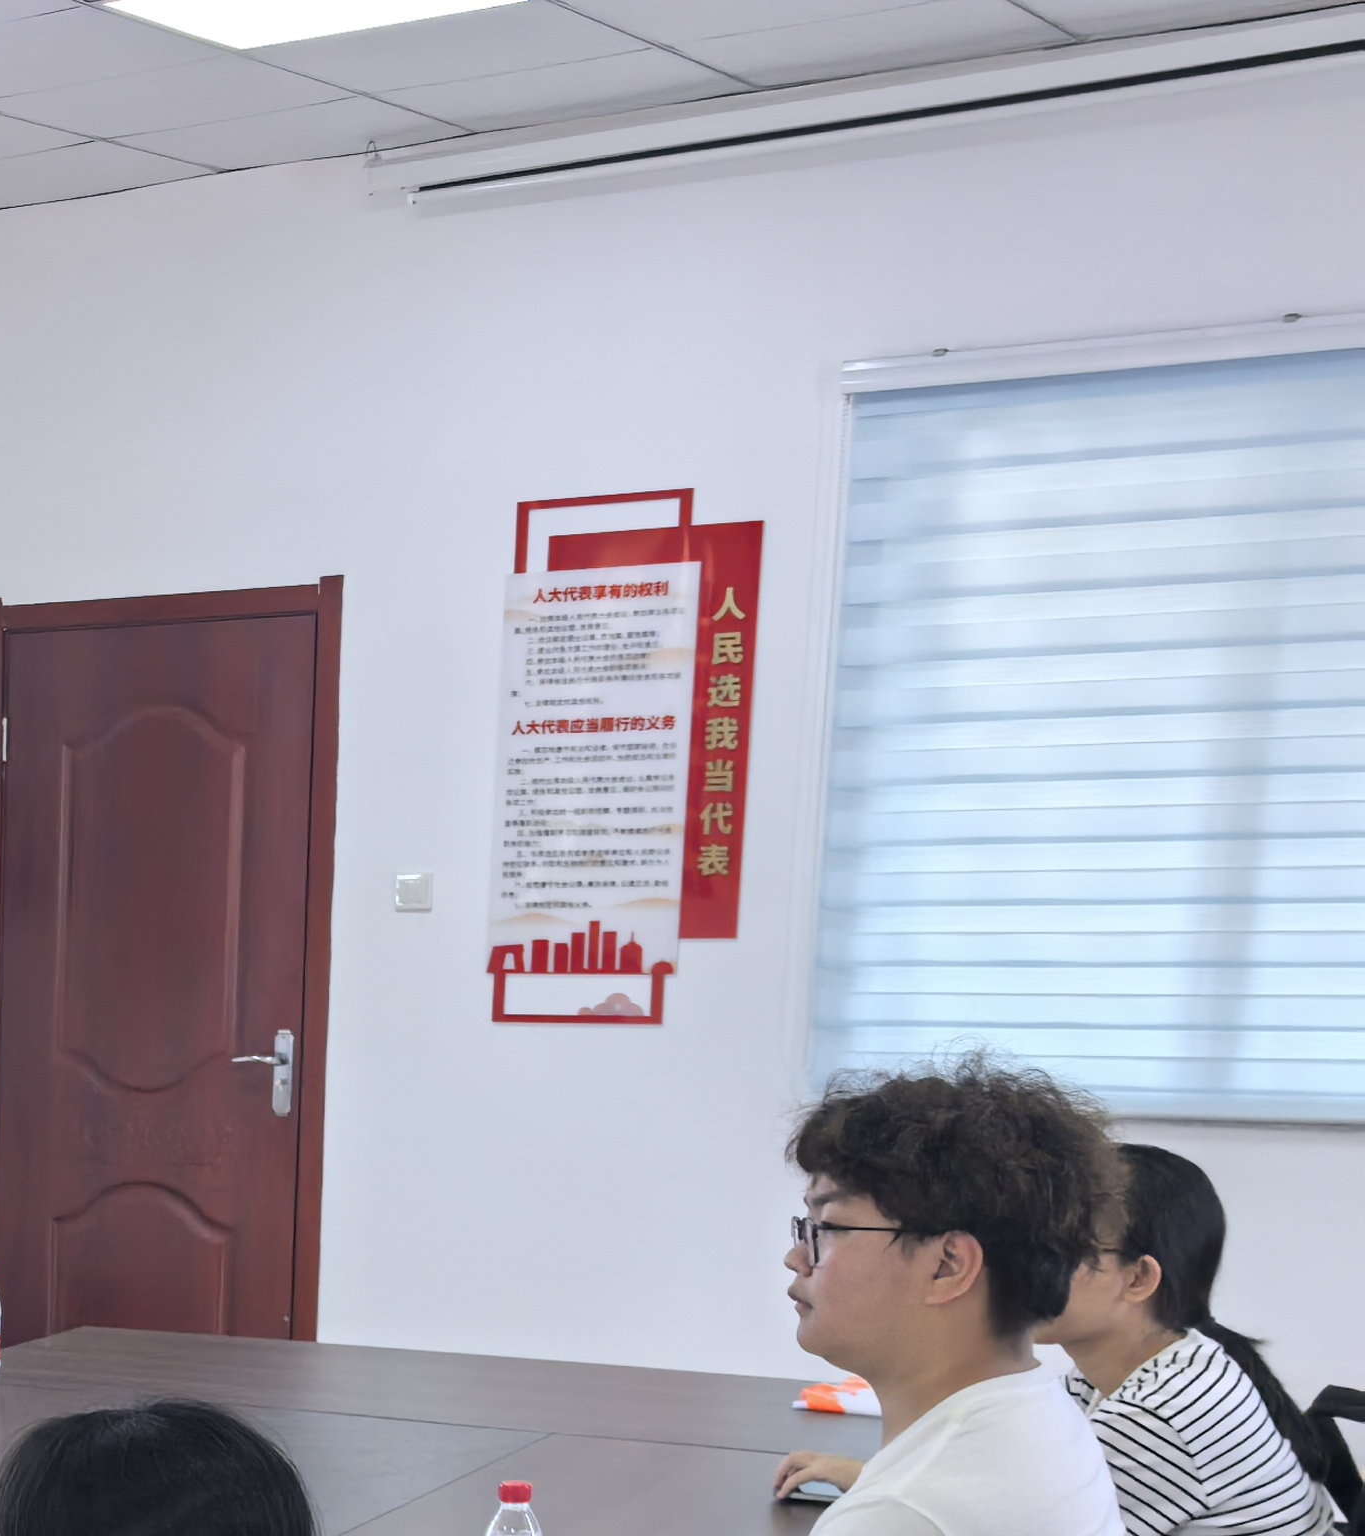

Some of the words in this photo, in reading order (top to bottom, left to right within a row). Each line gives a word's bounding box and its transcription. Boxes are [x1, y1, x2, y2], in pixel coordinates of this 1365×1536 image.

[533, 580, 670, 604] 人大代表享有的权利
[511, 715, 677, 736] 人大代表应当履行的义务
[697, 587, 746, 877] 人民选我当代表
